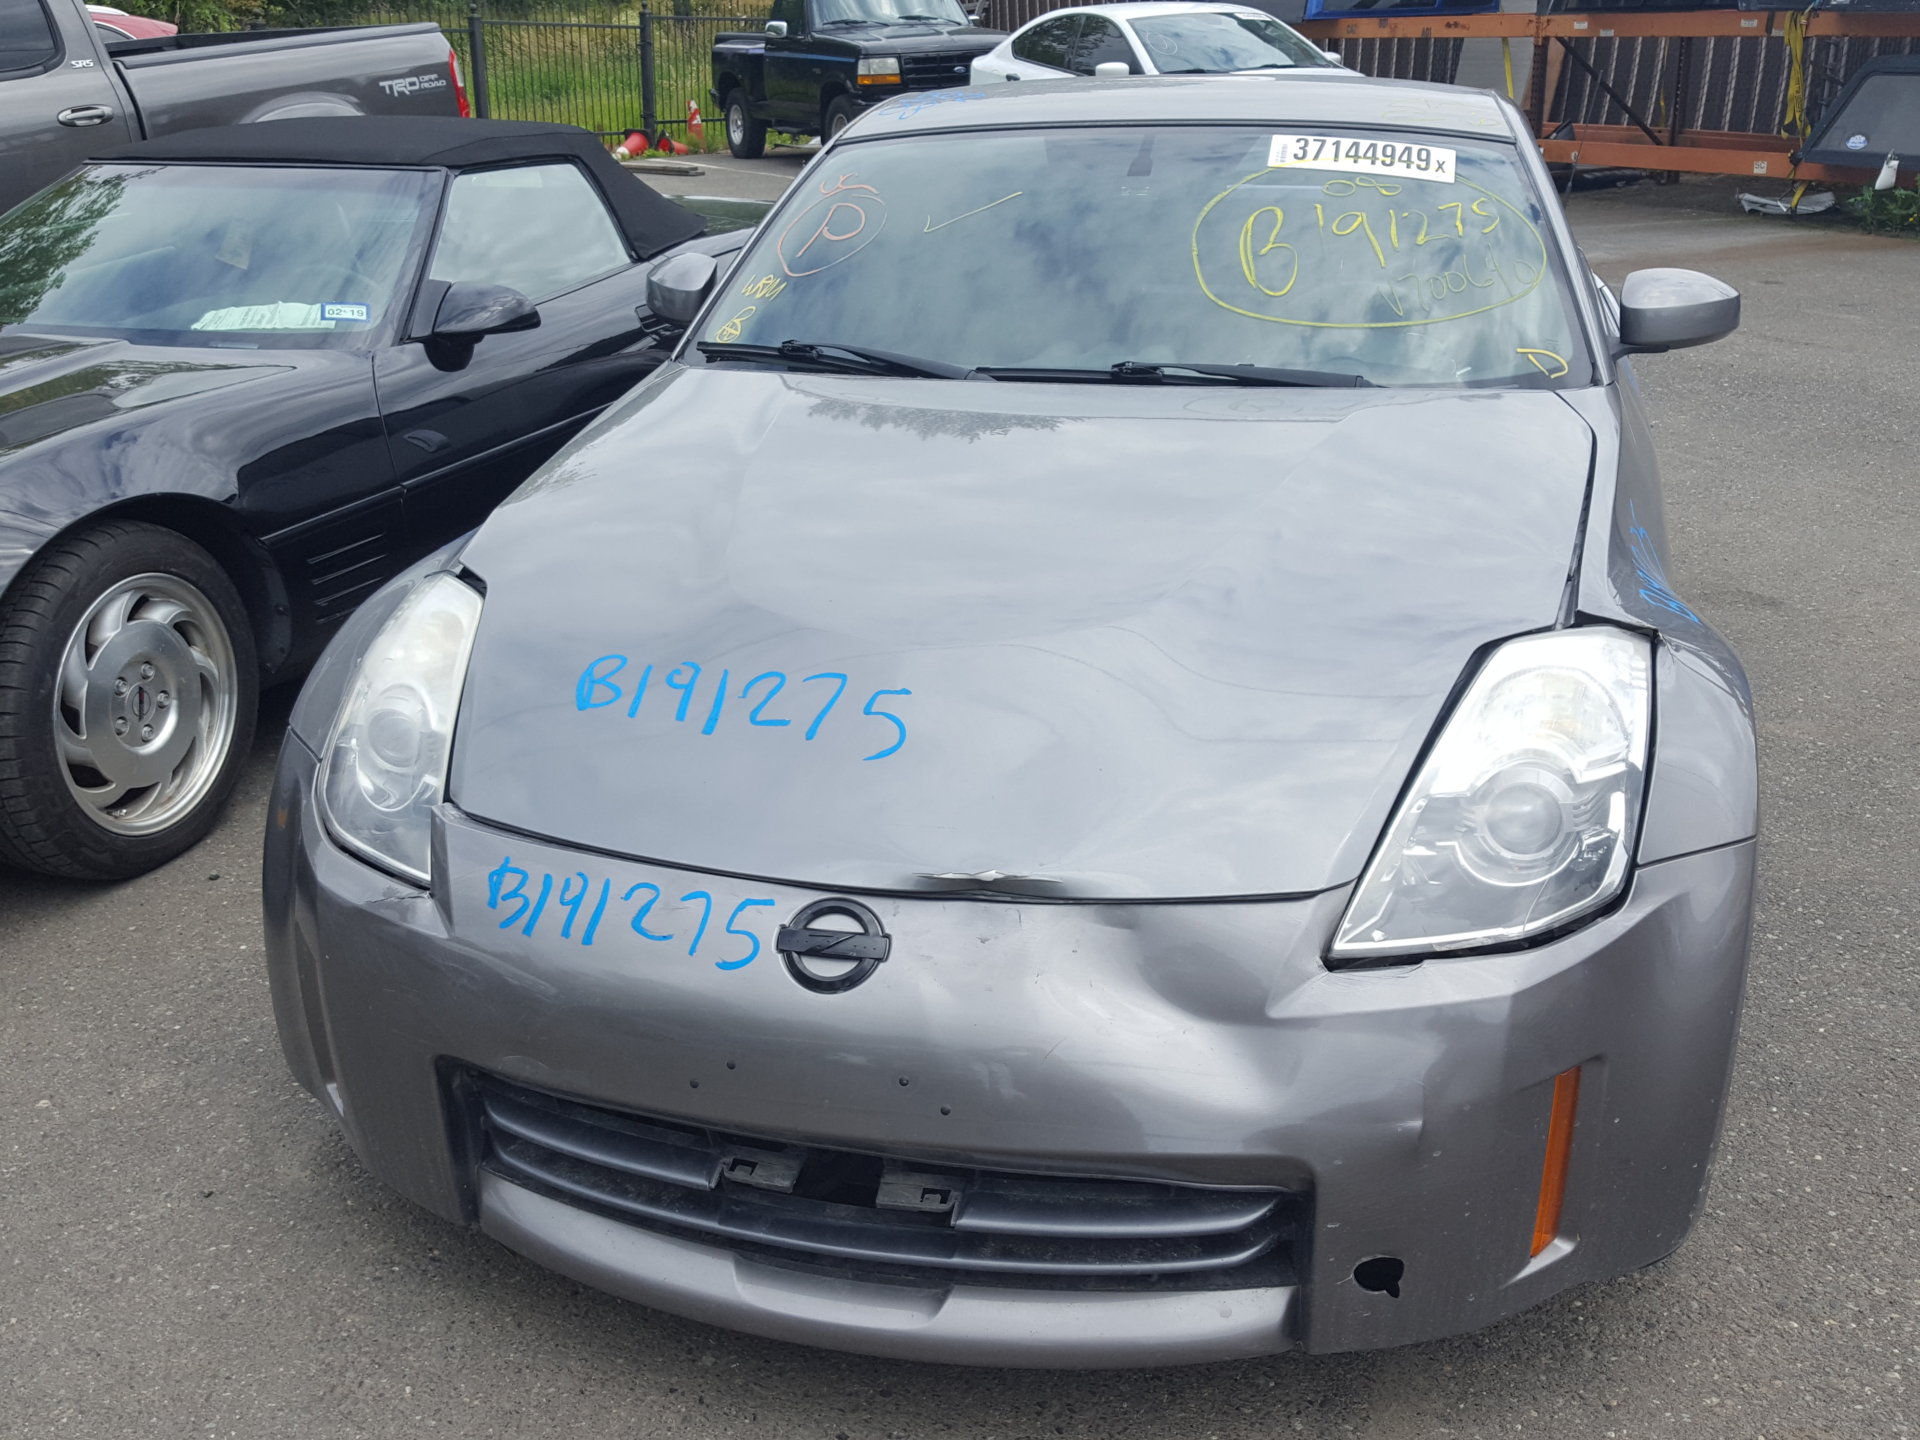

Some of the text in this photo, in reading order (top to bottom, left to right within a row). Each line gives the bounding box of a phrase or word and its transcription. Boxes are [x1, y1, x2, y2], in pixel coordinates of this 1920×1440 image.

[71, 59, 94, 69] SR5
[419, 74, 438, 82] OFF
[420, 80, 447, 89] ROAD
[379, 77, 419, 97] TRD
[576, 654, 913, 761] B191275
[488, 855, 775, 971] B191275
